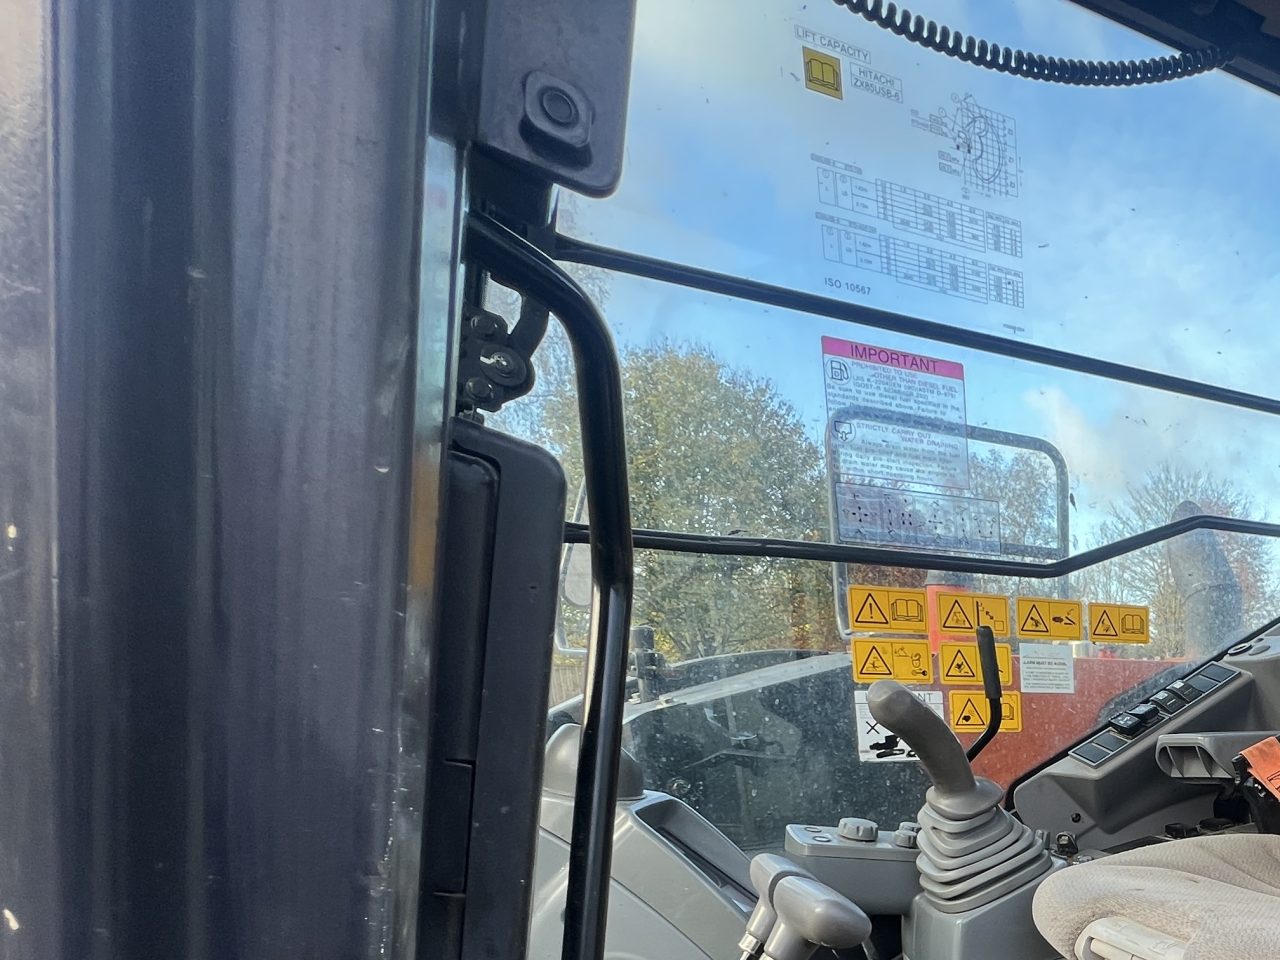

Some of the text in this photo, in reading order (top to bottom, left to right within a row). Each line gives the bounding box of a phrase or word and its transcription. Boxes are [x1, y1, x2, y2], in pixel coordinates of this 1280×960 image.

[796, 28, 868, 60] LIFT CAPACITY
[858, 67, 895, 87] HITACHI
[824, 277, 871, 295] ISO 10567
[850, 344, 939, 373] IMPORTANT
[942, 385, 958, 393] FUEL
[856, 422, 888, 433] STRICTLY
[892, 428, 914, 436] CARRY
[902, 436, 924, 444] WATER
